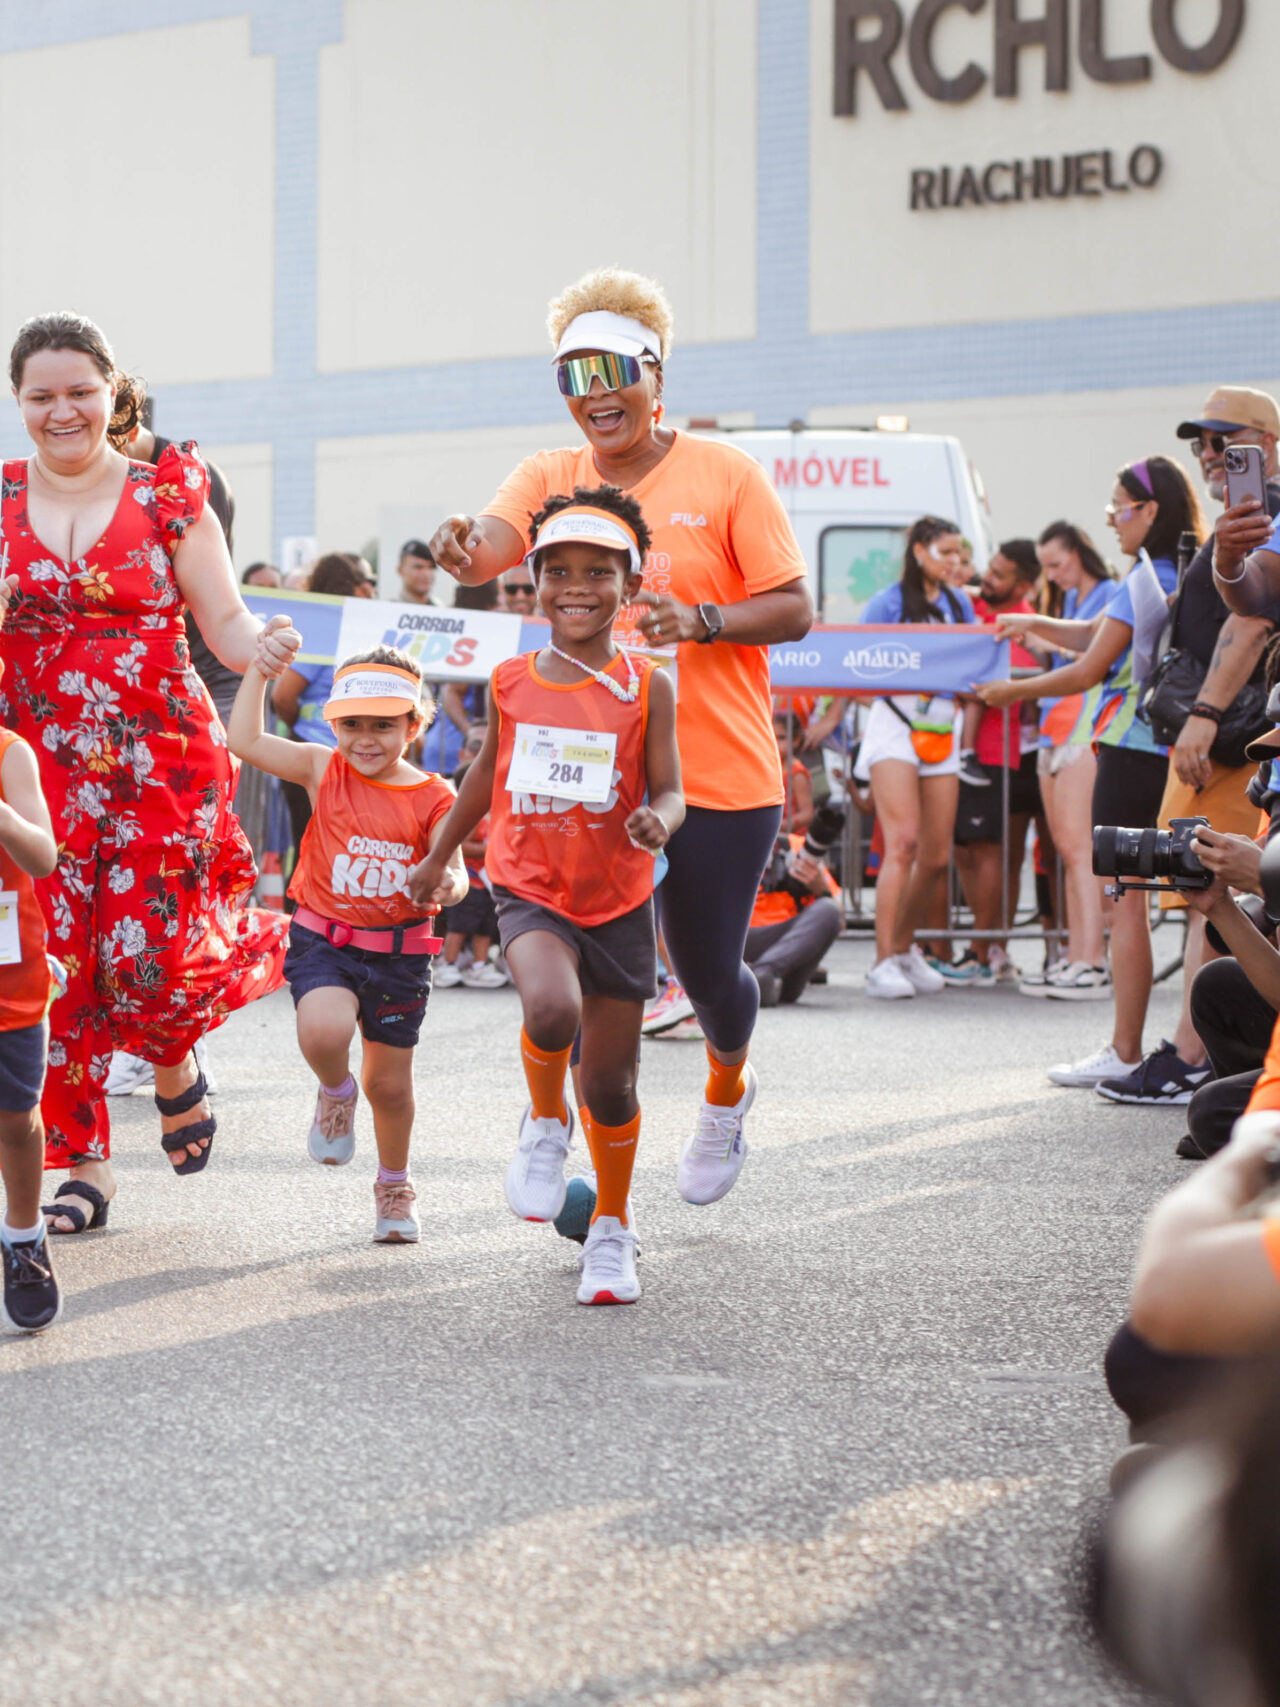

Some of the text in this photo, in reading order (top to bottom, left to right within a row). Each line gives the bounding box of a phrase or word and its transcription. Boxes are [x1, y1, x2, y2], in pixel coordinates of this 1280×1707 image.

[833, 0, 1246, 117] RCHLO
[909, 144, 1163, 210] RIACHUELO
[774, 449, 890, 487] MÓVEL
[670, 513, 708, 527] FILA
[397, 613, 465, 634] CORRIDA
[548, 763, 583, 784] 284
[347, 835, 415, 860] CORRIDA
